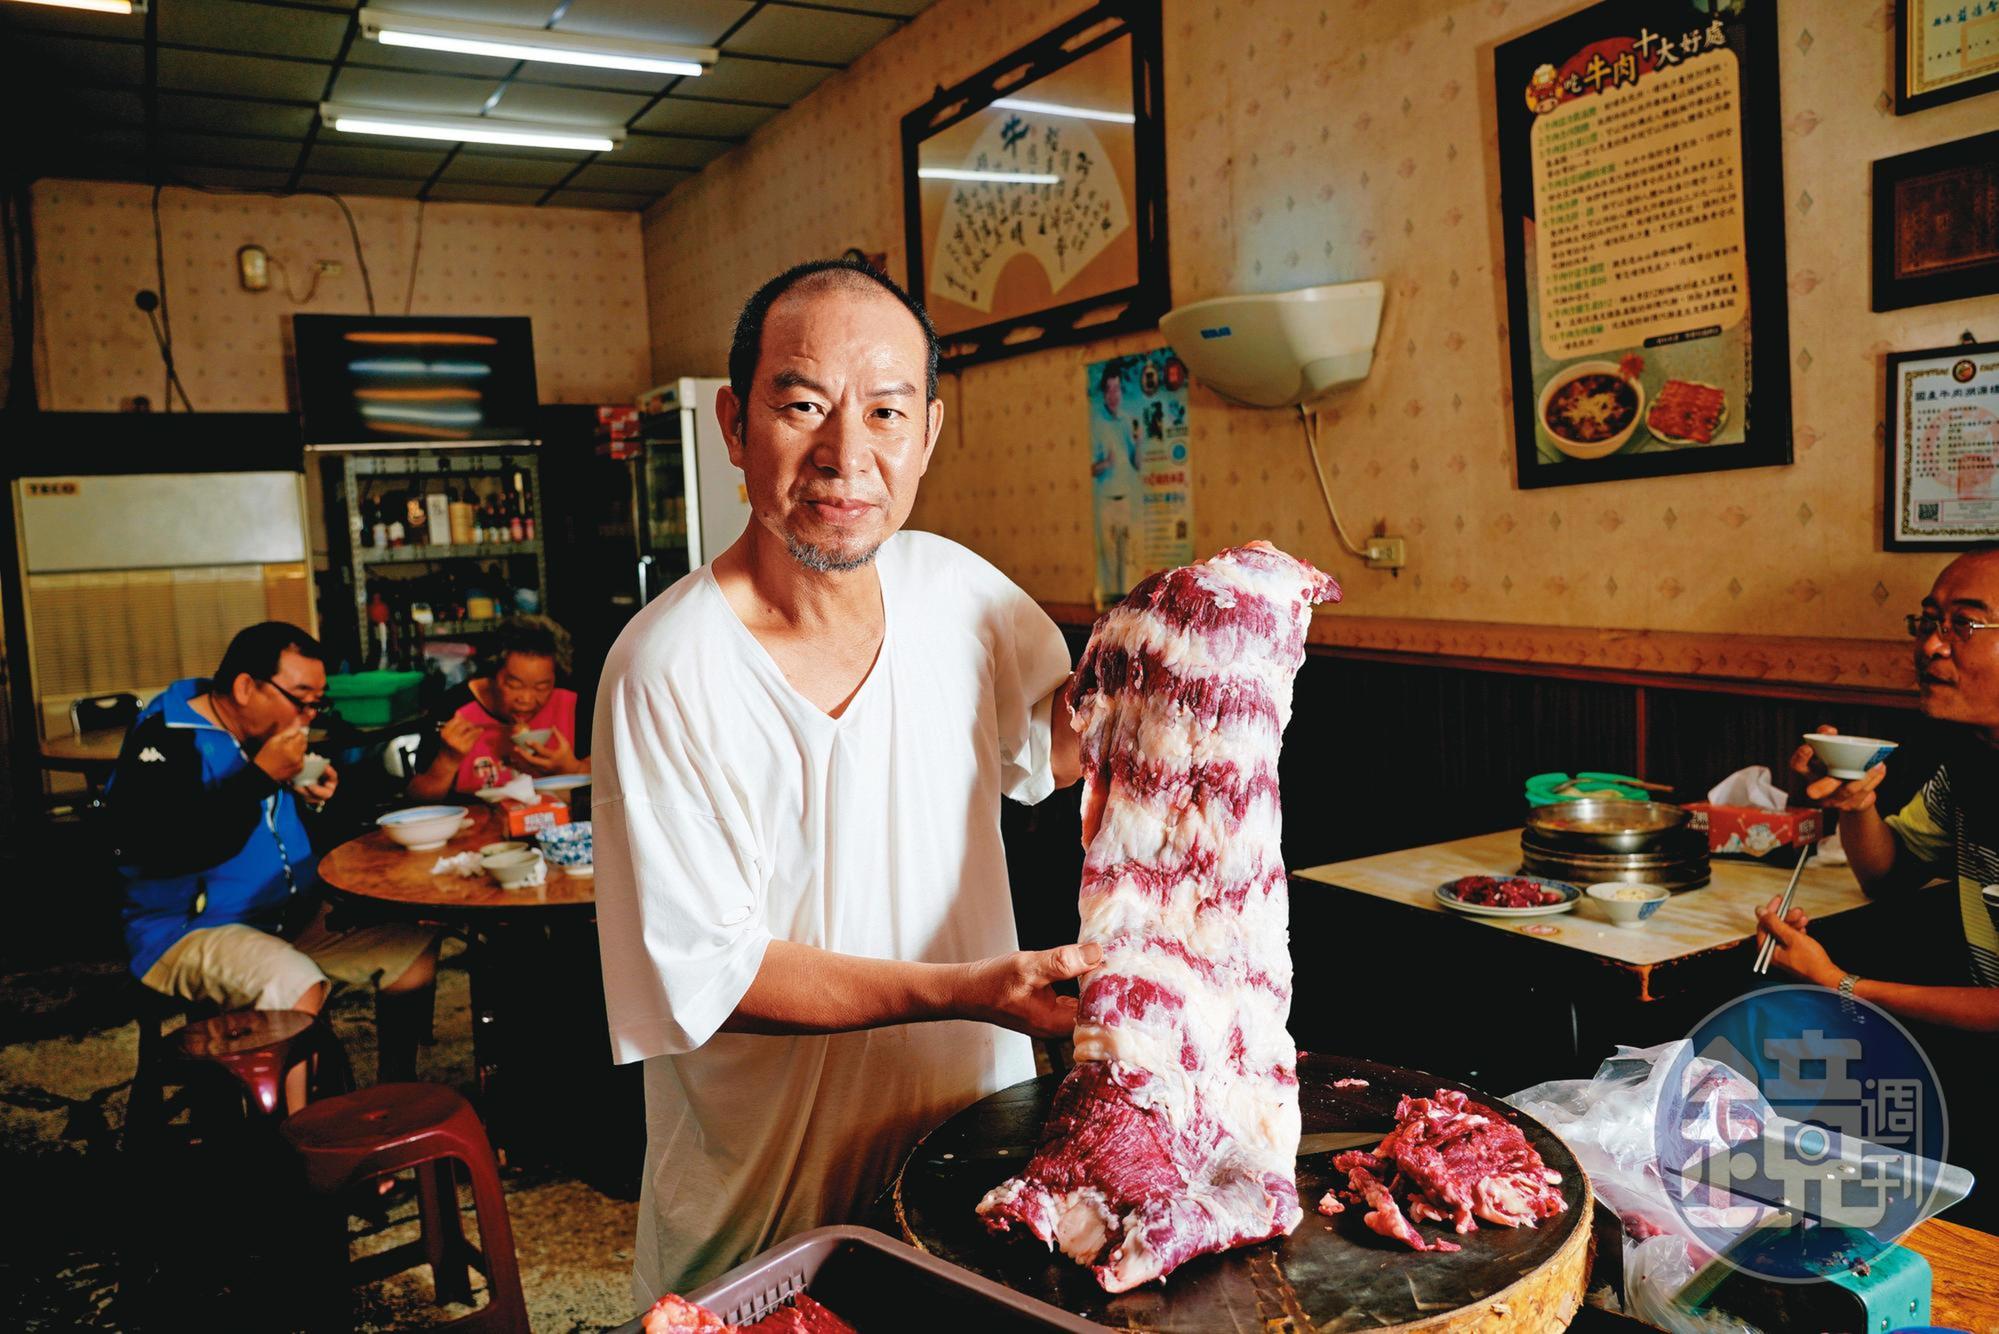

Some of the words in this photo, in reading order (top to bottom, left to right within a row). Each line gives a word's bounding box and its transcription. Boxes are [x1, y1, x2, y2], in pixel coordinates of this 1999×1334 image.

[1563, 20, 1727, 95] 吃牛肉十大好處
